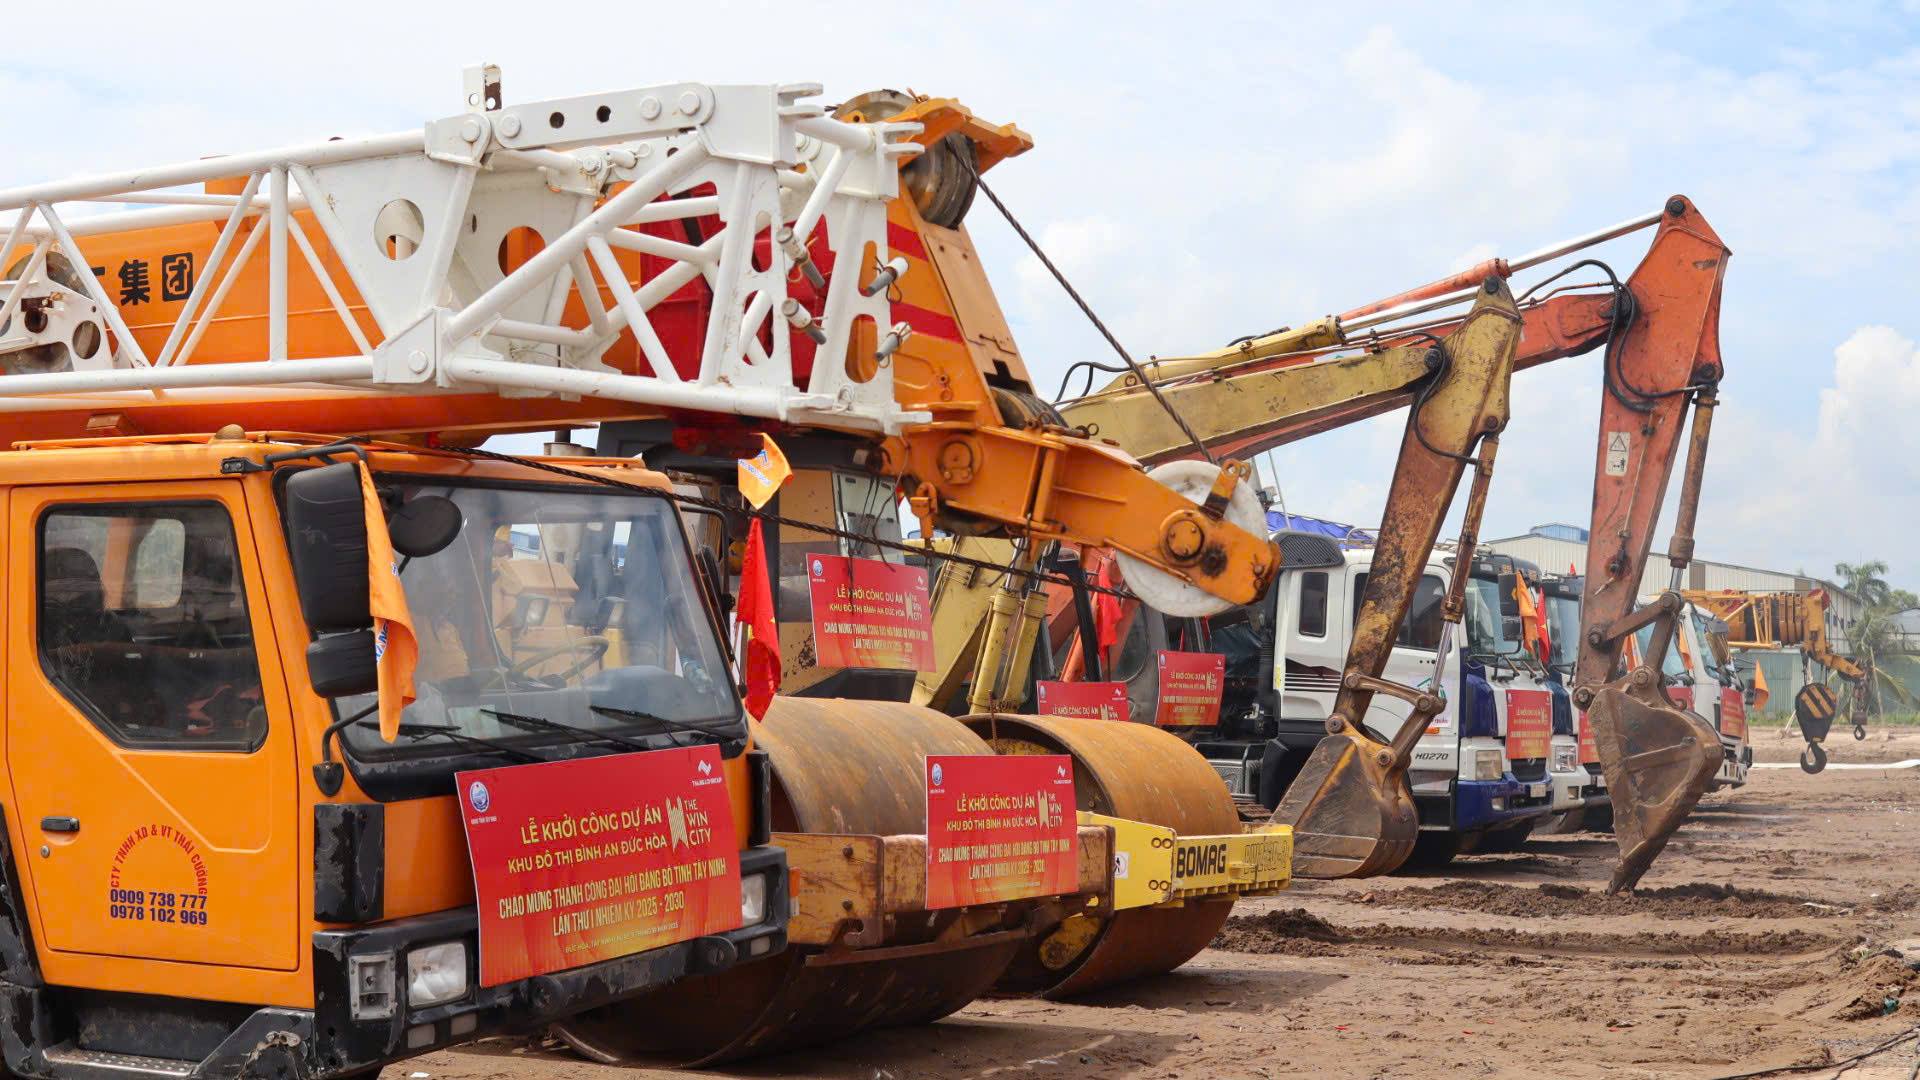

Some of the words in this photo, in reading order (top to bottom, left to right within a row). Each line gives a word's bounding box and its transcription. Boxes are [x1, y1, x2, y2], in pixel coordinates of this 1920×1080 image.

[1415, 752, 1449, 760] HD270
[685, 799, 698, 811] THE
[521, 817, 539, 845] LỄ
[542, 814, 577, 840] KHỞI
[580, 811, 618, 835] CÔNG
[621, 806, 640, 831] DỰ
[644, 804, 662, 826] ÁN
[687, 811, 708, 827] WIN
[151, 824, 158, 836] &
[161, 825, 173, 838] VT
[689, 828, 711, 846] CITY
[115, 835, 136, 864] TNHH
[508, 857, 533, 873] KHU
[535, 850, 553, 869] ĐÔ
[555, 849, 574, 868] THỊ
[576, 844, 602, 862] BÌNH
[604, 842, 619, 858] AN
[620, 836, 643, 854] ĐỨC
[645, 832, 667, 850] HÒA
[1176, 844, 1227, 878] BOMAG
[110, 866, 121, 888] CTY
[110, 889, 144, 905] 0909
[149, 892, 175, 907] 738
[180, 894, 207, 910] 777
[637, 896, 658, 918] 2025
[664, 891, 685, 912] 2030
[110, 905, 144, 921] 0978
[149, 908, 175, 923] 102
[180, 910, 207, 925] 969
